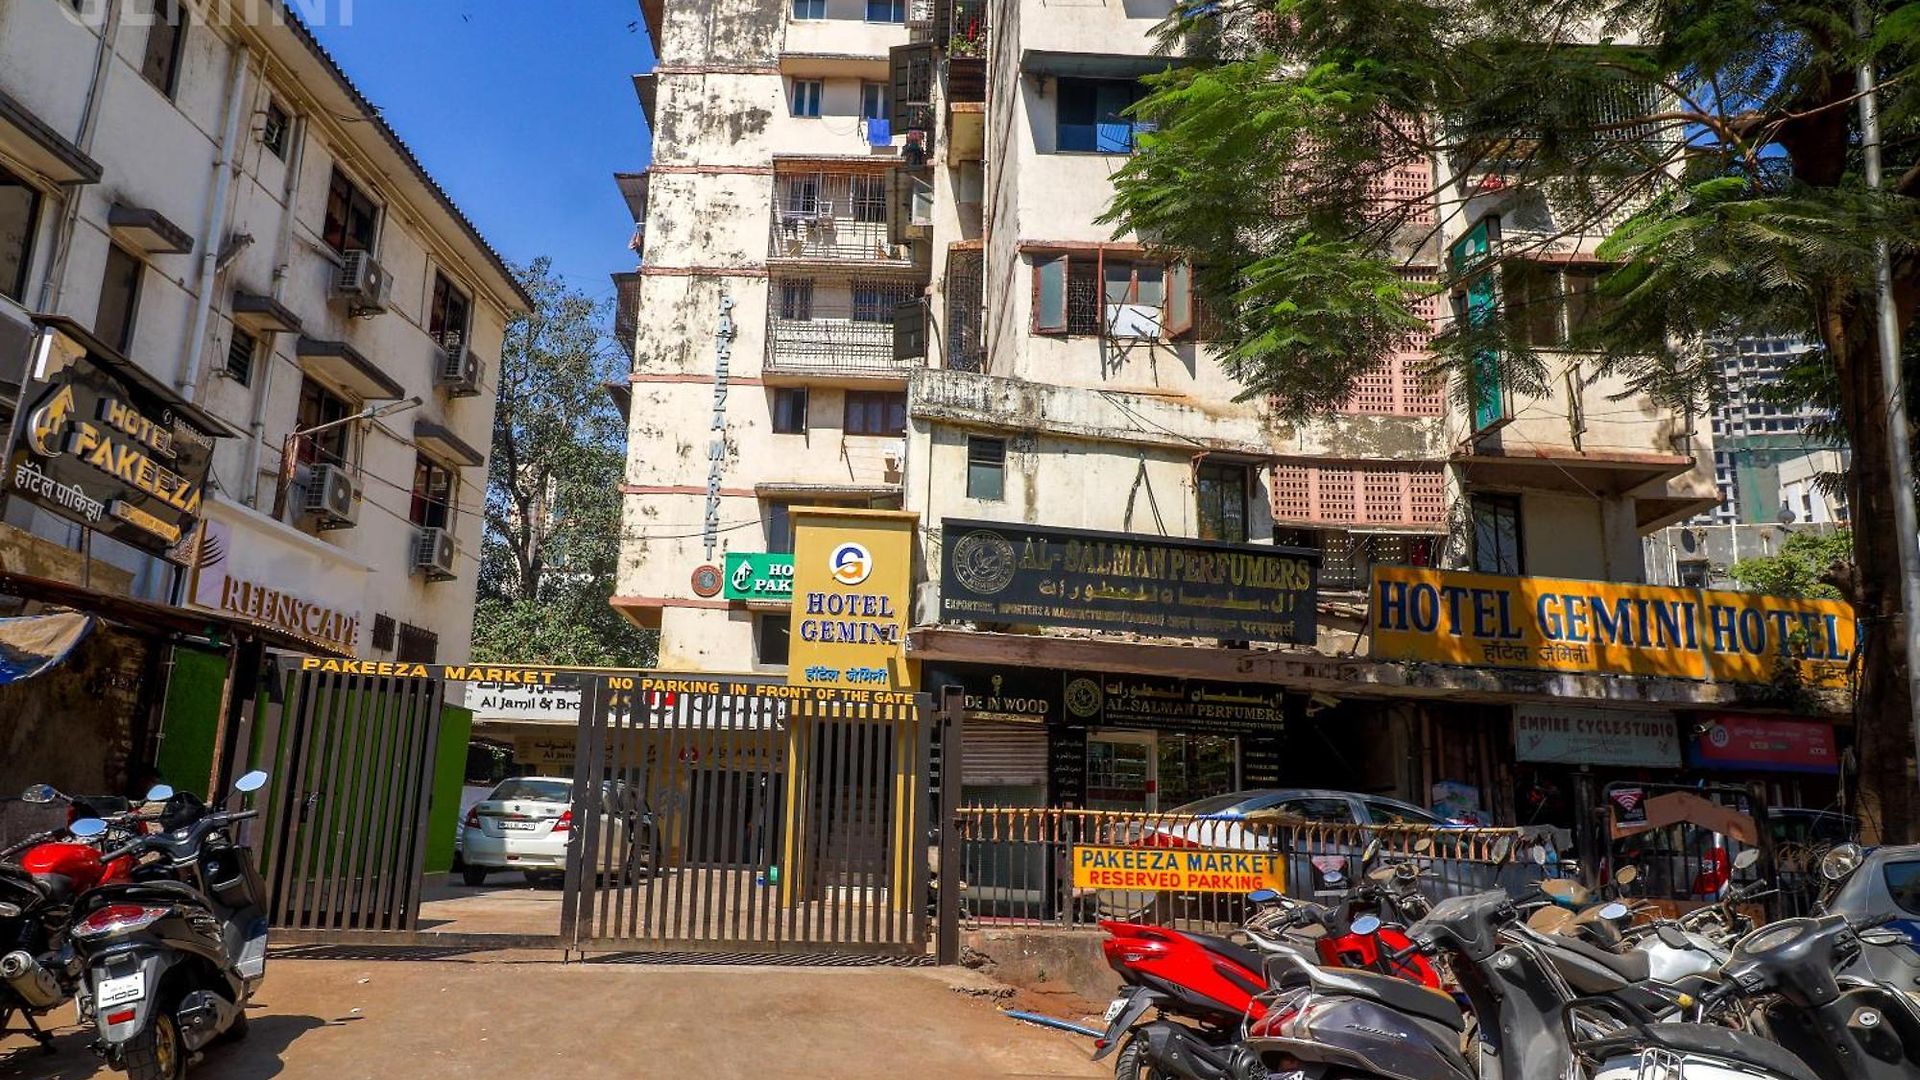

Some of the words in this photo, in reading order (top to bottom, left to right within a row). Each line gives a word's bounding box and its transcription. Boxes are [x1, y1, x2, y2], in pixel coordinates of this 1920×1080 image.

[710, 295, 734, 432] PAKEEZA
[104, 399, 177, 459] HOTEL
[66, 421, 201, 517] PAKEEZA
[703, 439, 726, 561] MARKET
[768, 563, 795, 578] HO
[1170, 548, 1311, 592] PERFUMERS
[754, 580, 793, 593] PAK
[806, 592, 894, 618] HOTEL
[1378, 579, 1524, 641] HOTEL
[1536, 592, 1699, 652] GEMINI
[801, 619, 899, 646] GEMINI
[1708, 605, 1850, 662] HOTEL
[302, 657, 429, 678] PAKEEZA
[444, 666, 556, 684] MARKET
[481, 696, 496, 709] Al
[499, 696, 536, 711] Jamil
[539, 697, 553, 711] &
[556, 698, 582, 710] Bro
[608, 677, 634, 690] NO
[641, 679, 720, 695] PARKING
[730, 683, 748, 696] IN
[756, 684, 808, 698] FRONT
[816, 687, 835, 699] OF
[841, 689, 870, 703] THE
[873, 691, 914, 705] GATE
[987, 697, 1001, 710] IN
[1003, 697, 1049, 714] WOOD
[1197, 703, 1285, 722] PERFUMERS
[1519, 715, 1569, 732] EMPIRE
[1081, 849, 1180, 872] PAKEEZA
[1186, 853, 1278, 875] MARKET
[1089, 870, 1181, 888] RESERVED
[1188, 873, 1264, 890] PARKING
